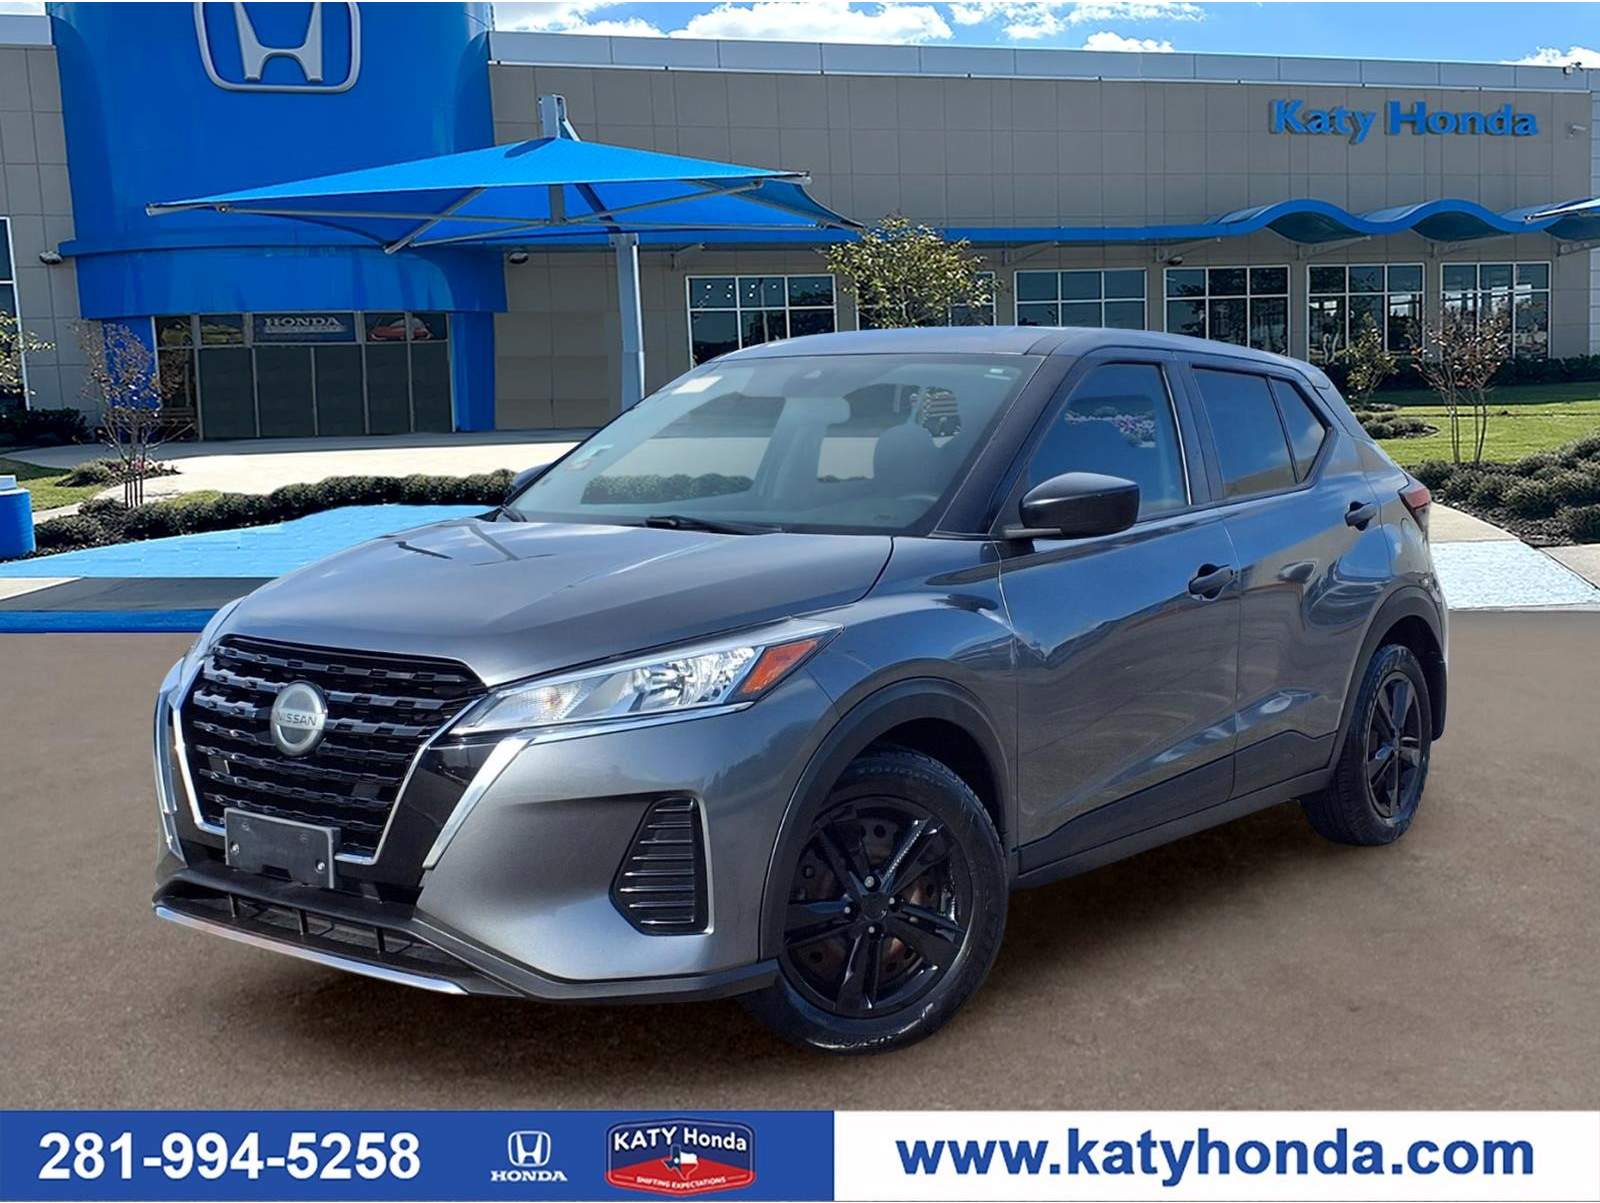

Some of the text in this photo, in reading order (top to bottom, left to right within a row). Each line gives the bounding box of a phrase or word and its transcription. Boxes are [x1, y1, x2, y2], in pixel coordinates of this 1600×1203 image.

[1270, 99, 1539, 144] Katy Honda
[265, 317, 341, 327] HONDA
[276, 710, 317, 726] NISSAN
